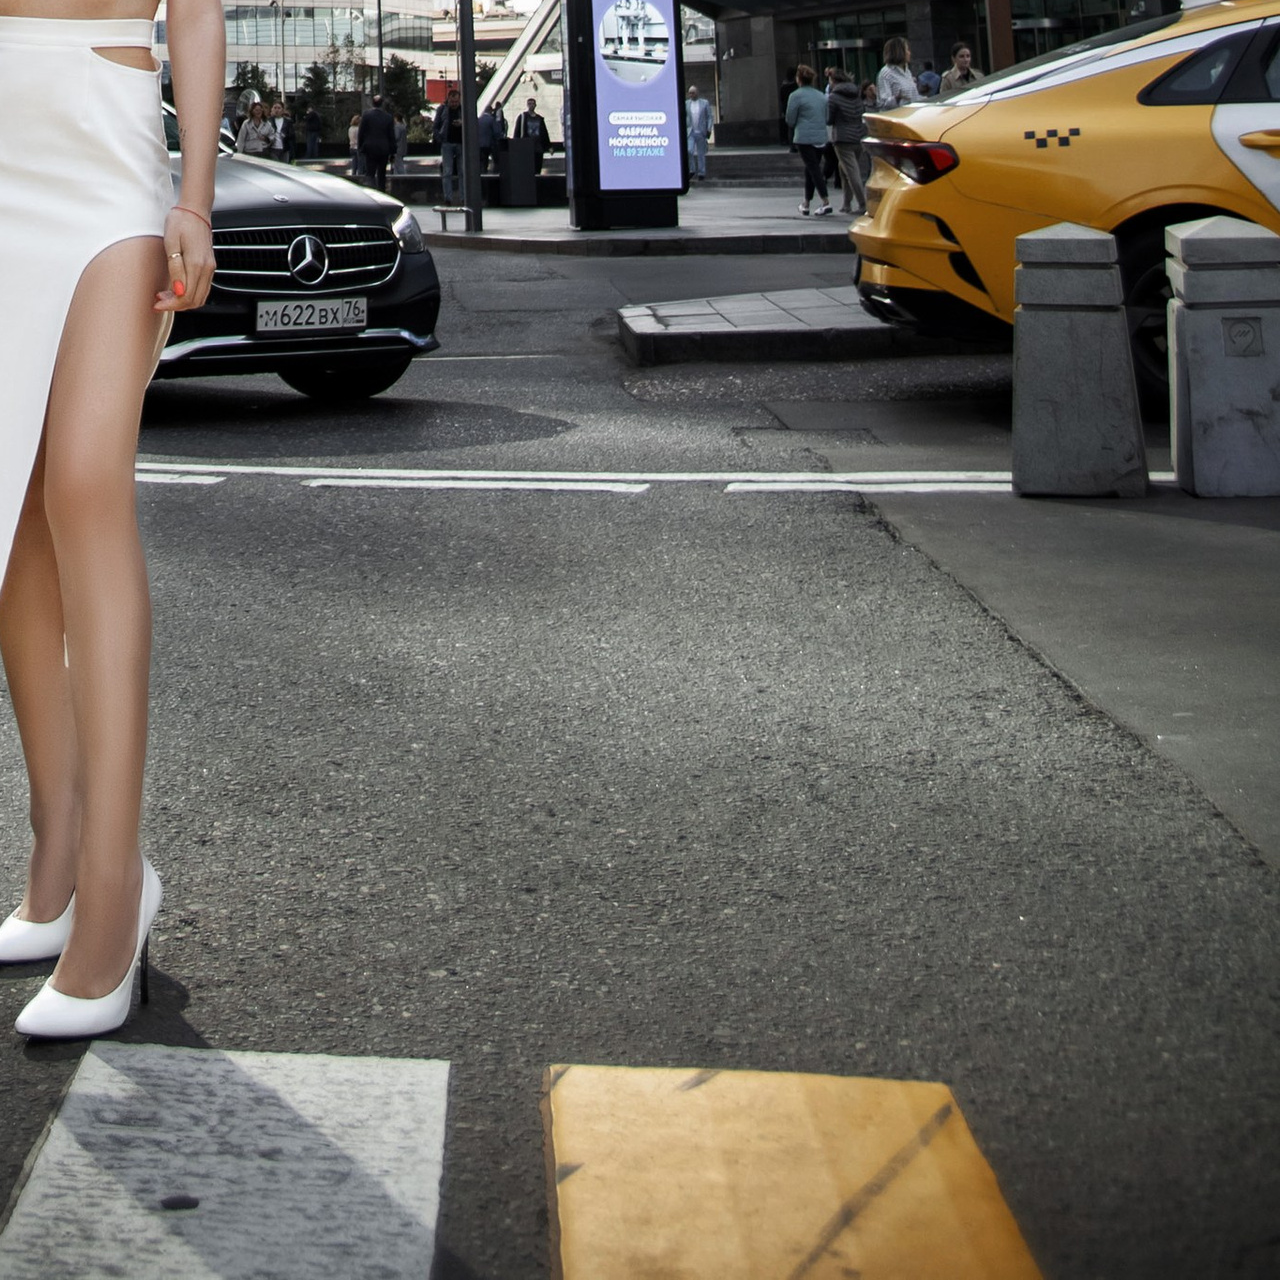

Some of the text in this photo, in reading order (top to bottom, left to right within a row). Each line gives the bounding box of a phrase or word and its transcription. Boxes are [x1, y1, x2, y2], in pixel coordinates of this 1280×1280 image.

[618, 126, 658, 136] ФАБРИКА
[609, 137, 669, 147] МОРОЖЕНОГО
[613, 147, 665, 157] НА 89 ЭТАЖЕ
[344, 300, 360, 317] 76
